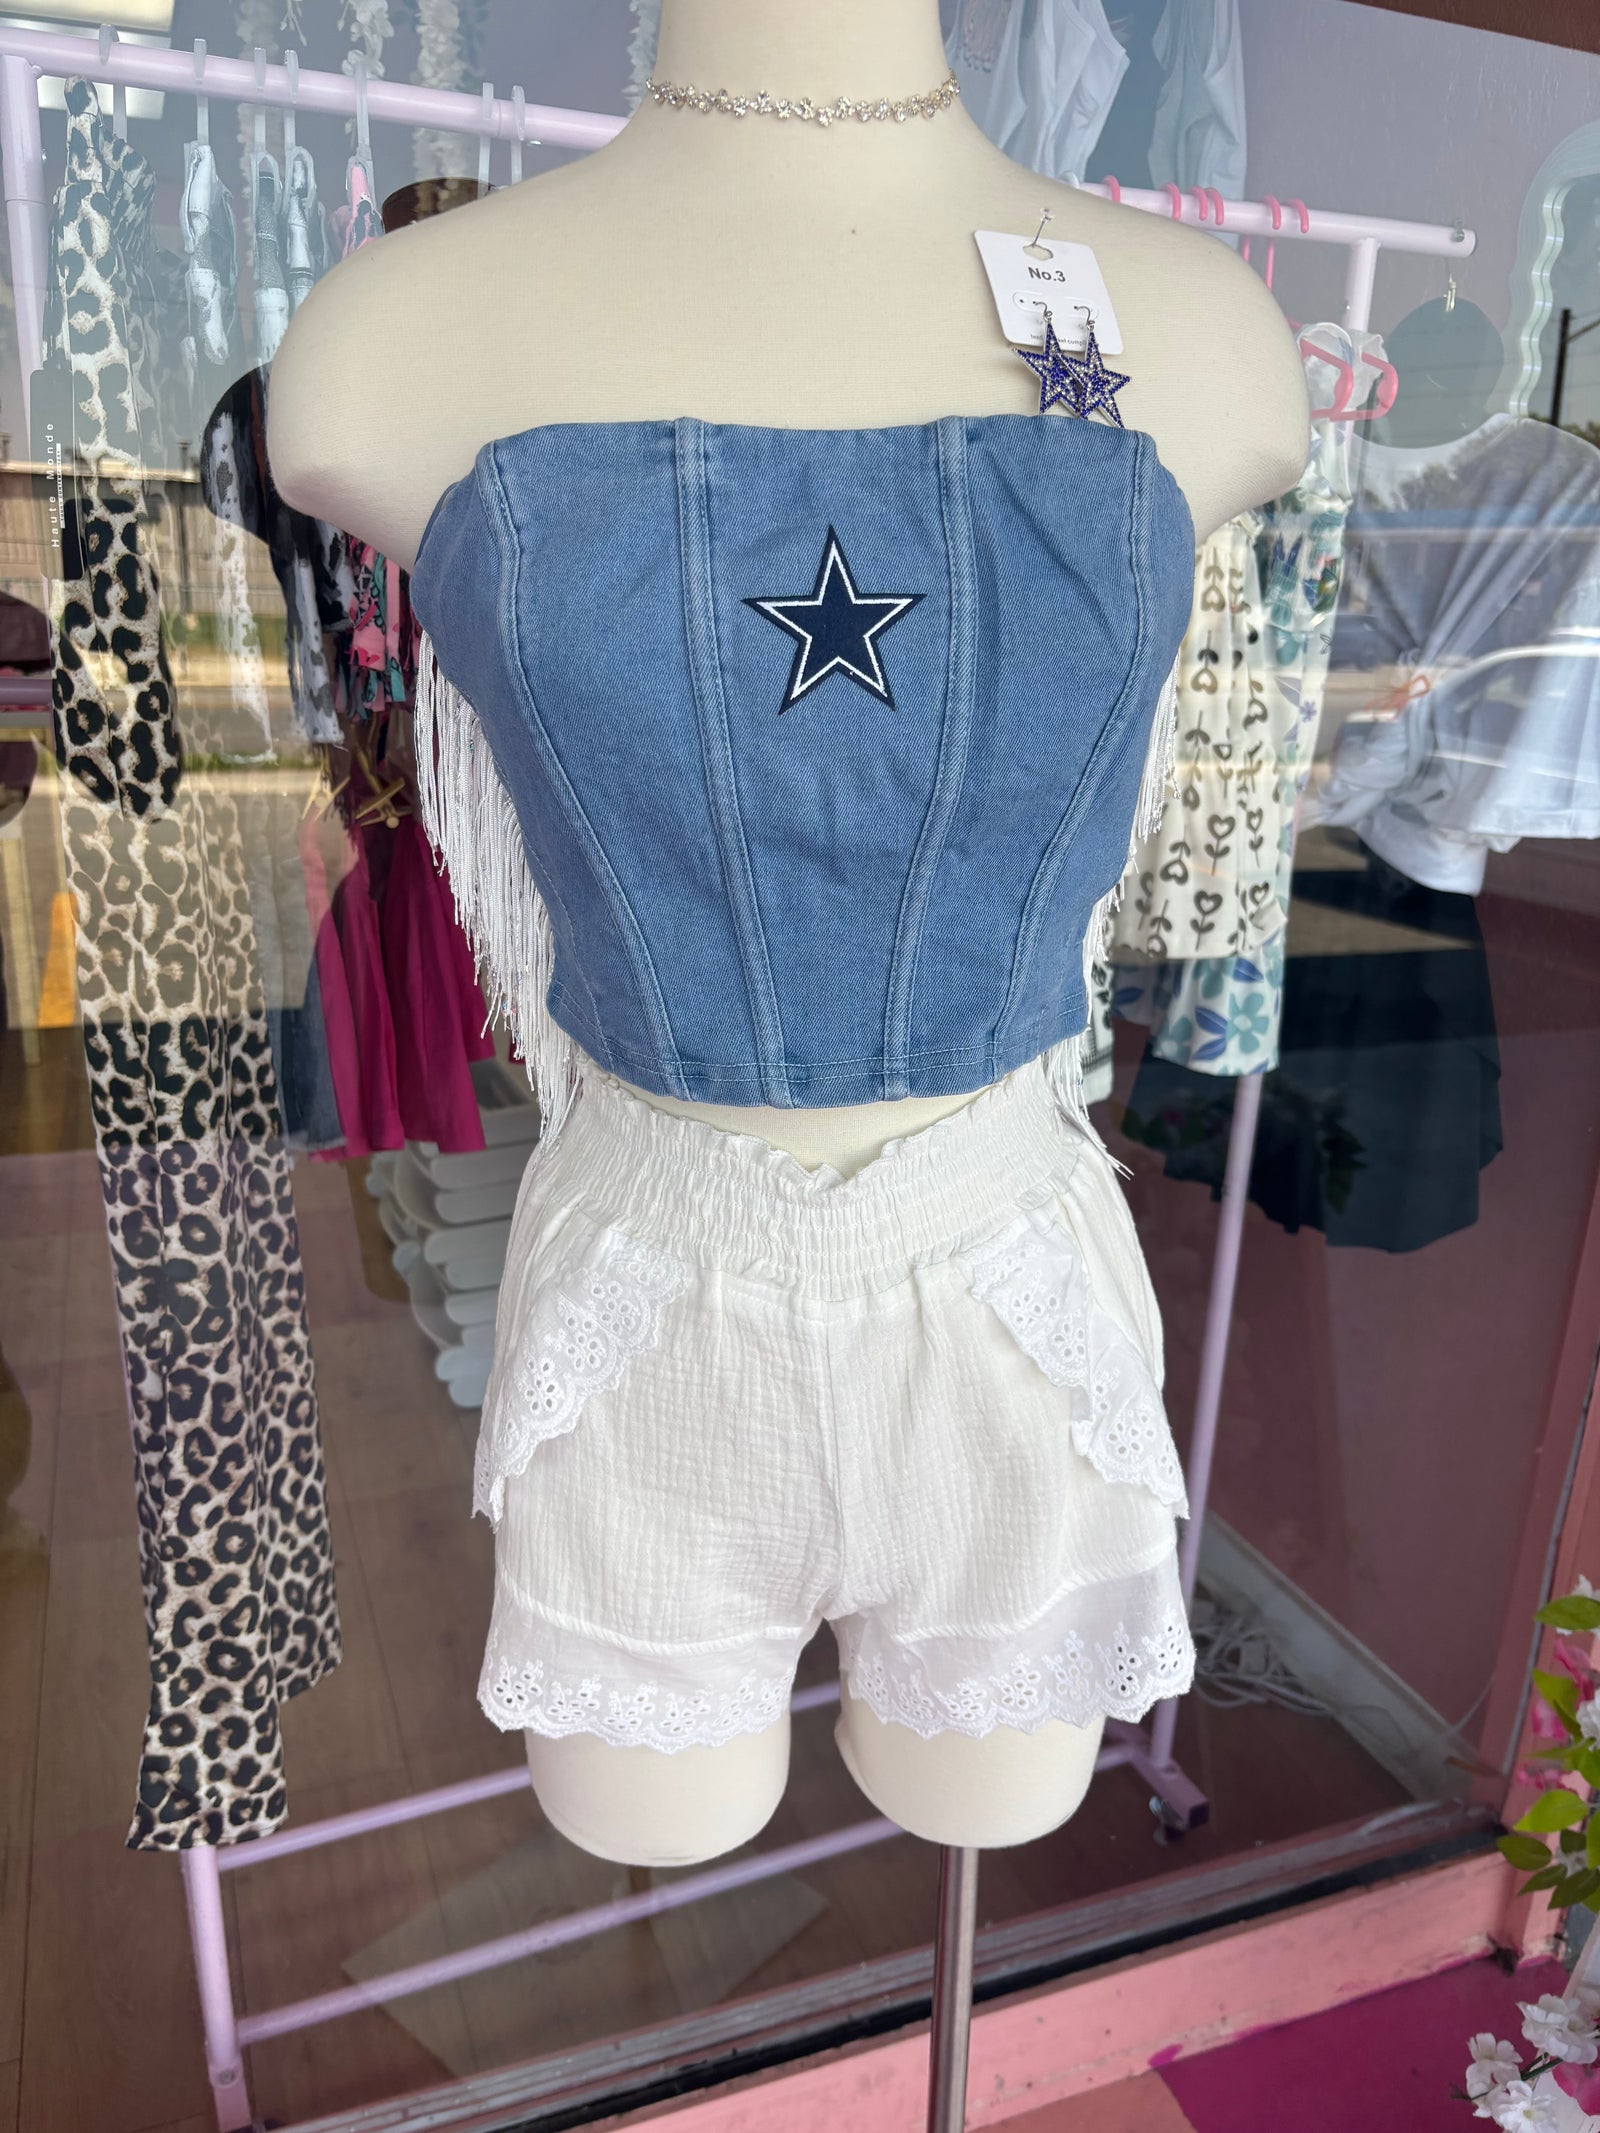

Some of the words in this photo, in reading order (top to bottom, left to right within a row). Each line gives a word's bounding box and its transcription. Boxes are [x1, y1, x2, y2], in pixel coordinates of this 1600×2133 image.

[1028, 266, 1066, 283] No.3
[45, 423, 55, 480] Monde
[48, 496, 60, 548] Haute
